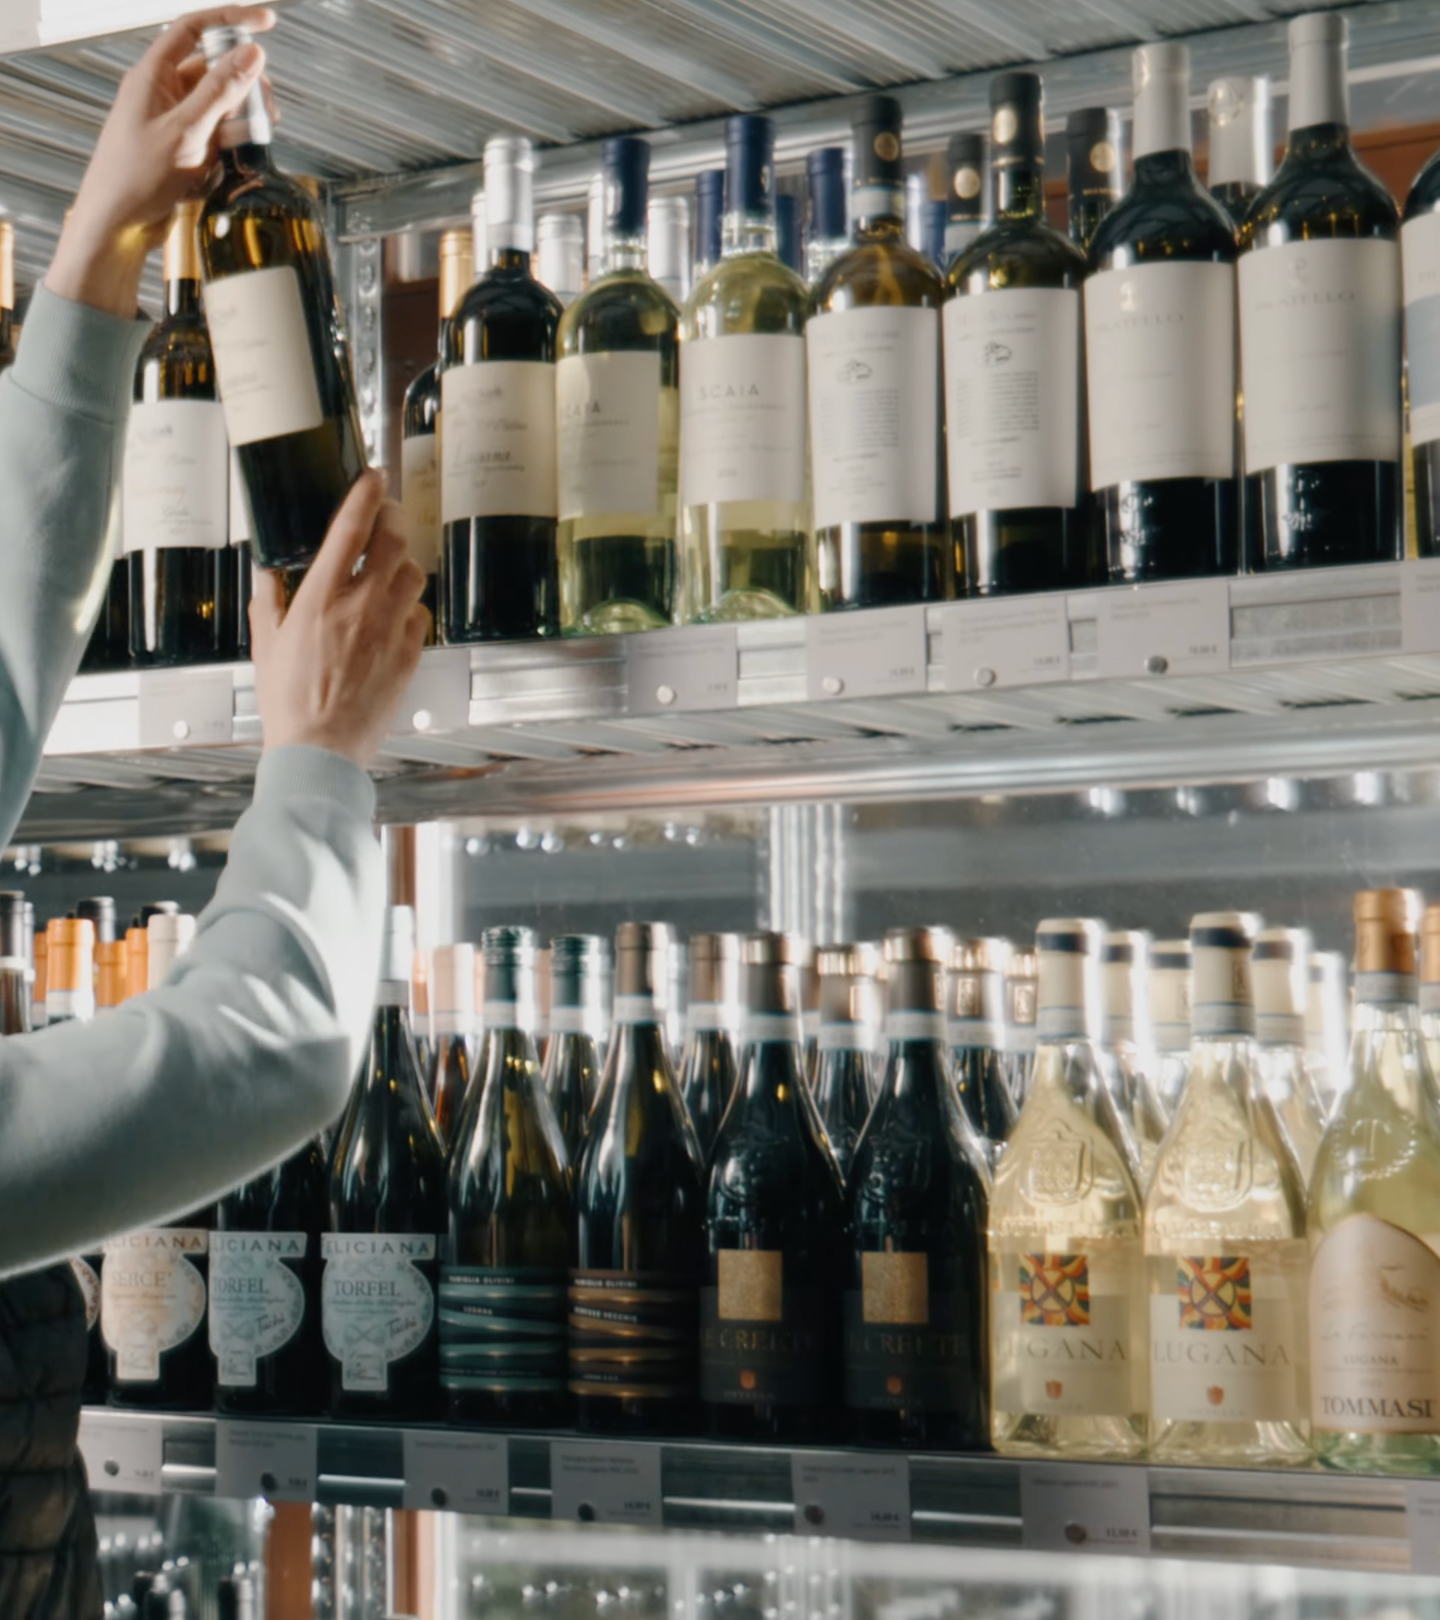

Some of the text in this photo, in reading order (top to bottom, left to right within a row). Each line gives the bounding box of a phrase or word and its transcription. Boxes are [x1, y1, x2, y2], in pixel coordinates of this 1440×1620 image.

[699, 383, 760, 400] SCAIA
[325, 1240, 429, 1255] ELICIANA
[333, 1280, 402, 1297] TORFEL
[1153, 1340, 1291, 1367] LUGANA
[1343, 1354, 1399, 1366] LUGANA
[1321, 1396, 1433, 1419] TOMMASI
